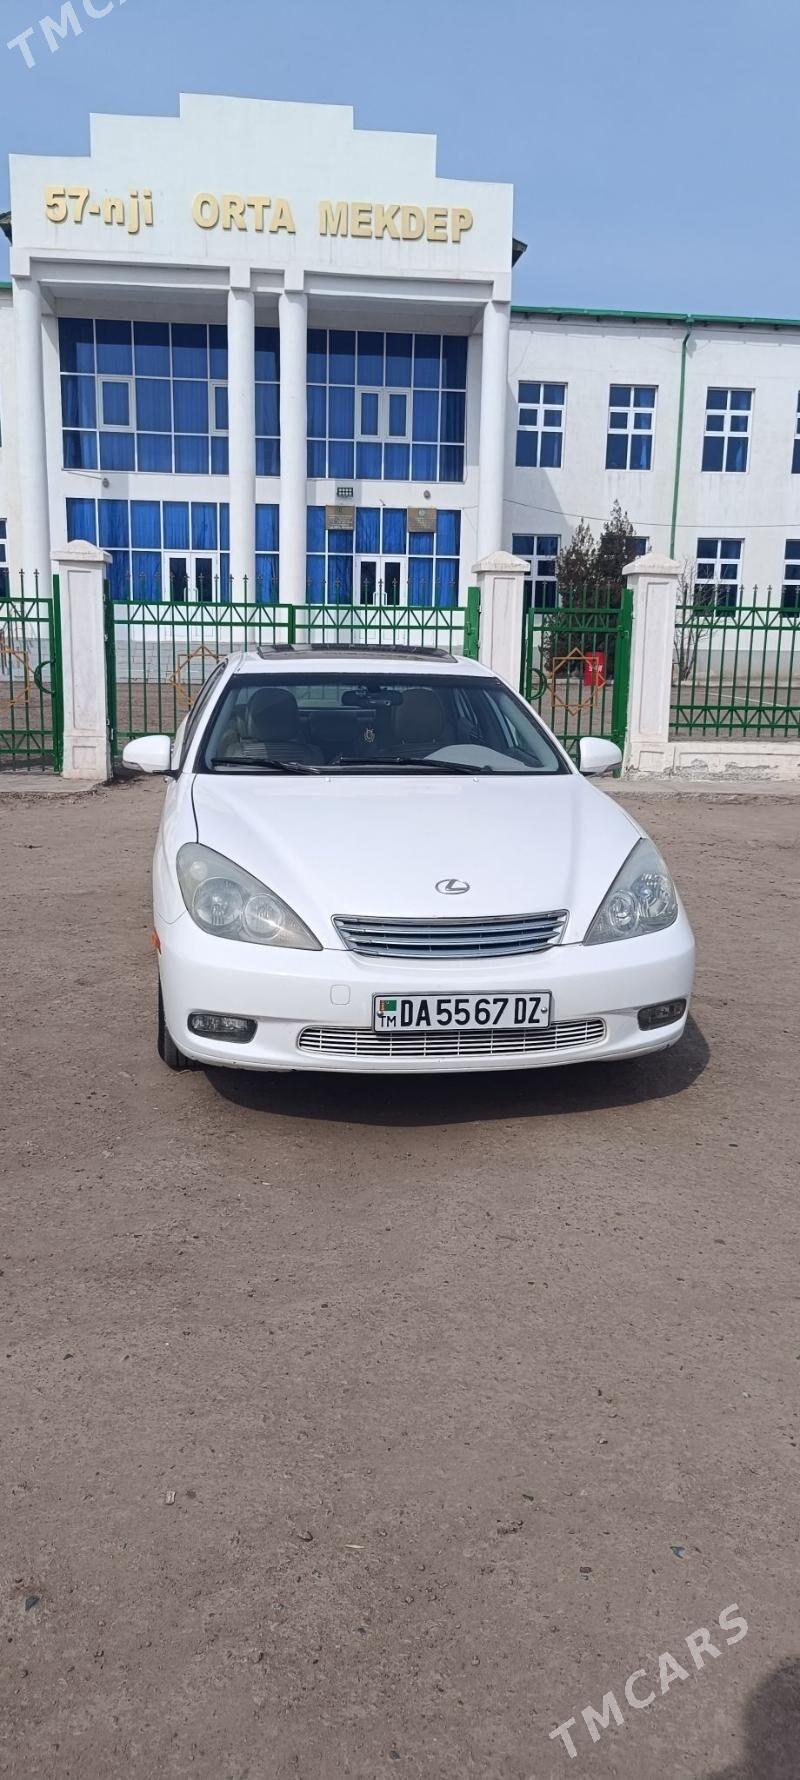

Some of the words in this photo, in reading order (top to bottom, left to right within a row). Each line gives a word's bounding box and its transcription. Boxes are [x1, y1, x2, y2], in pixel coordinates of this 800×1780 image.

[44, 186, 154, 235] 57-nji
[192, 191, 297, 235] ORTA
[319, 200, 474, 244] MEKDEP
[380, 1015, 397, 1028] TM
[513, 997, 542, 1025] DZ
